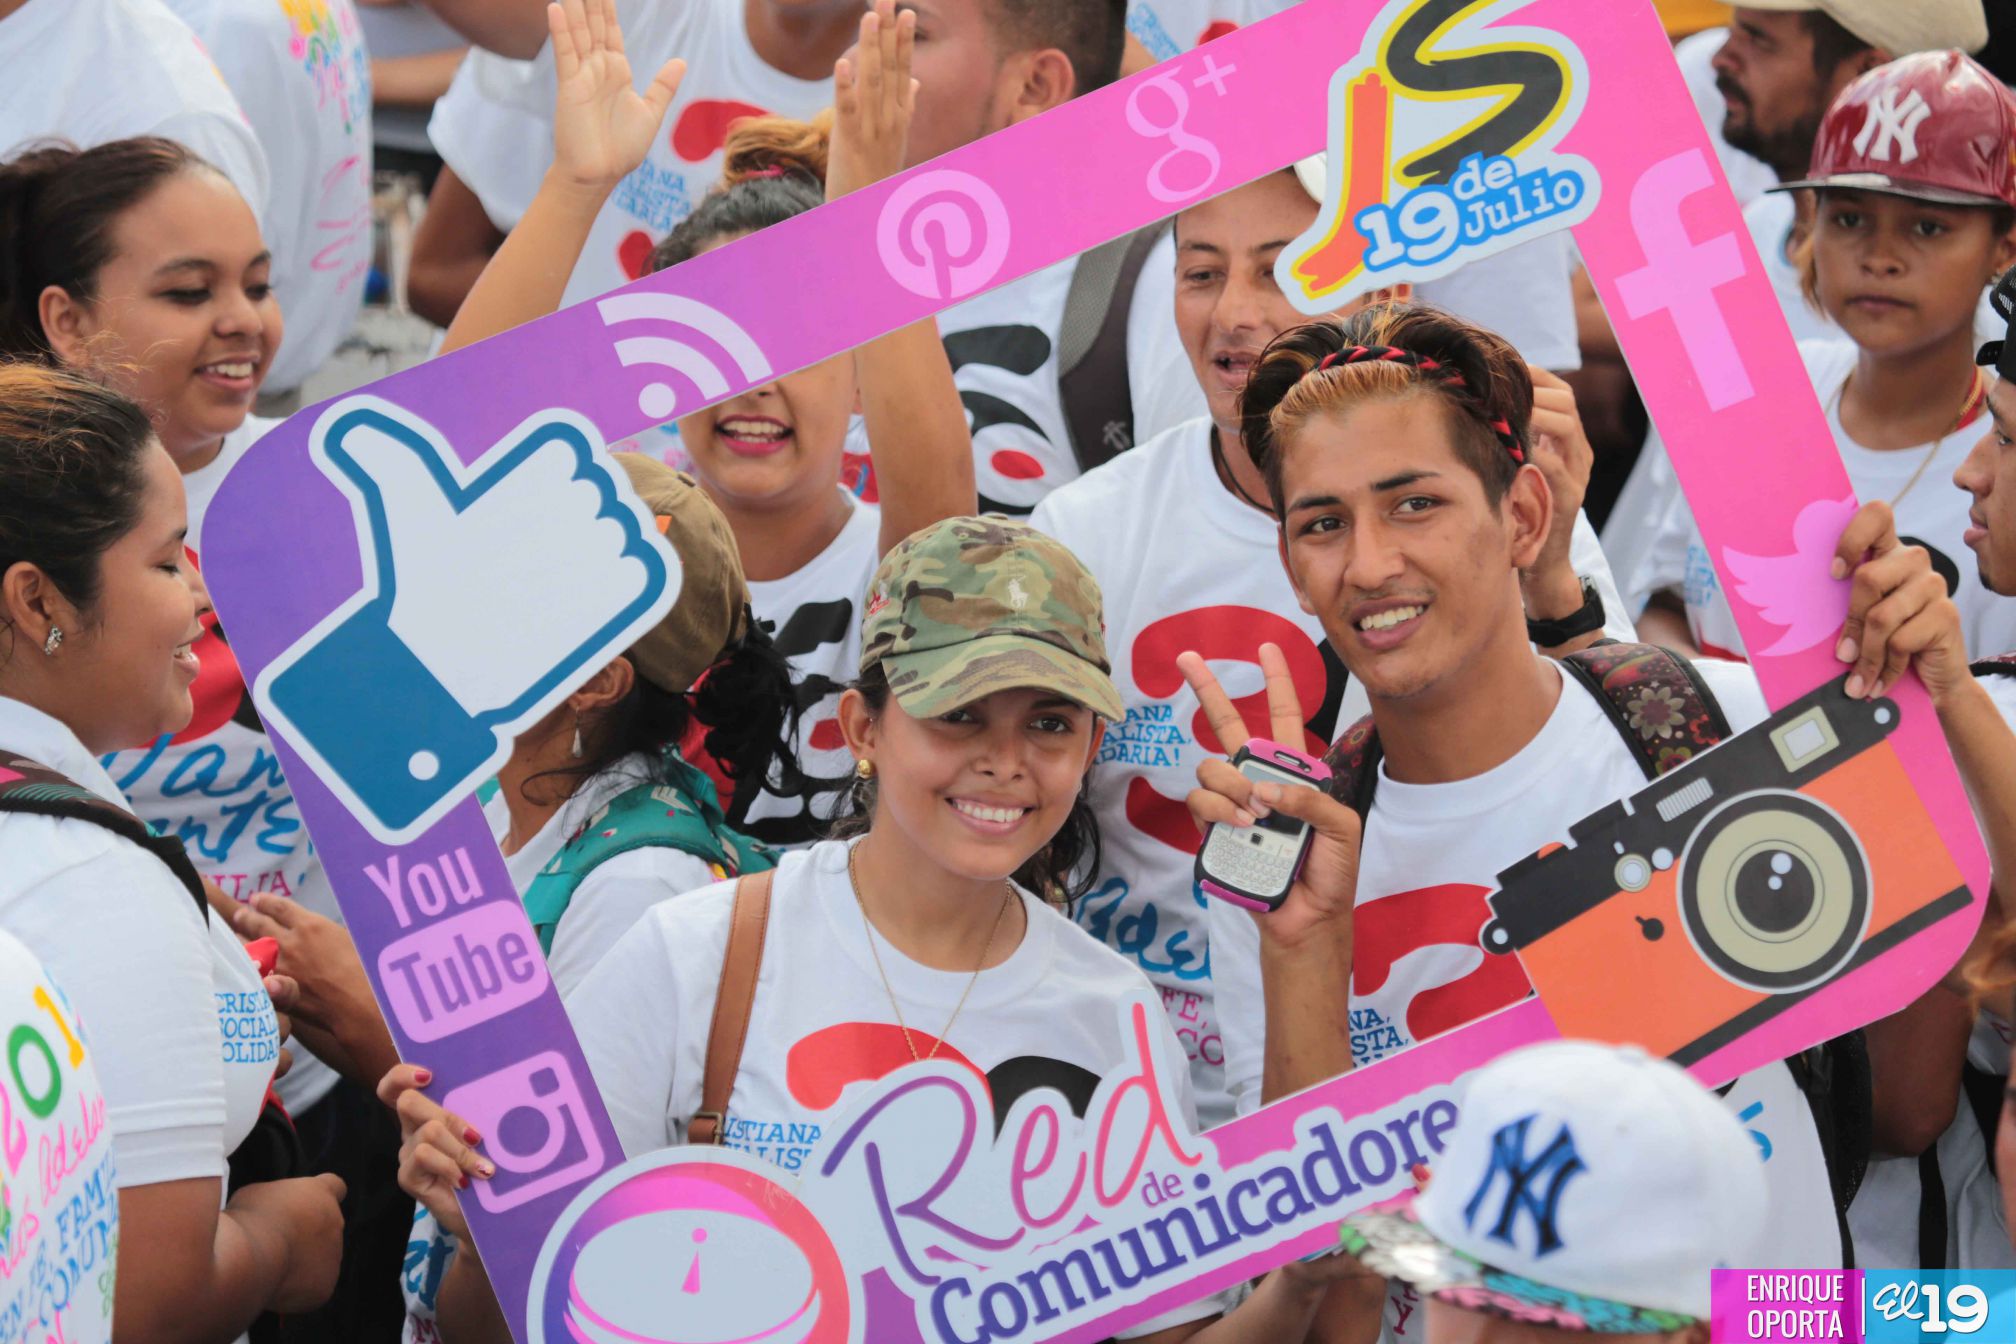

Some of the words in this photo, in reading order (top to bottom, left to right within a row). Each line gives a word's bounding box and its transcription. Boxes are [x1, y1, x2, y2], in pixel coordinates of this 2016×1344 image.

[1852, 83, 1932, 164] NY
[1453, 157, 1514, 201] de
[1464, 178, 1577, 238] Julio
[1360, 190, 1460, 267] 19
[1102, 722, 1192, 746] ALISTA,
[362, 846, 484, 929] You
[387, 932, 536, 1024] Tube
[724, 1117, 822, 1146] ISTIANA
[820, 1001, 1204, 1287] Red
[930, 1098, 1459, 1344] Comunicadore
[1140, 1170, 1184, 1209] de
[1463, 1111, 1589, 1259] NY
